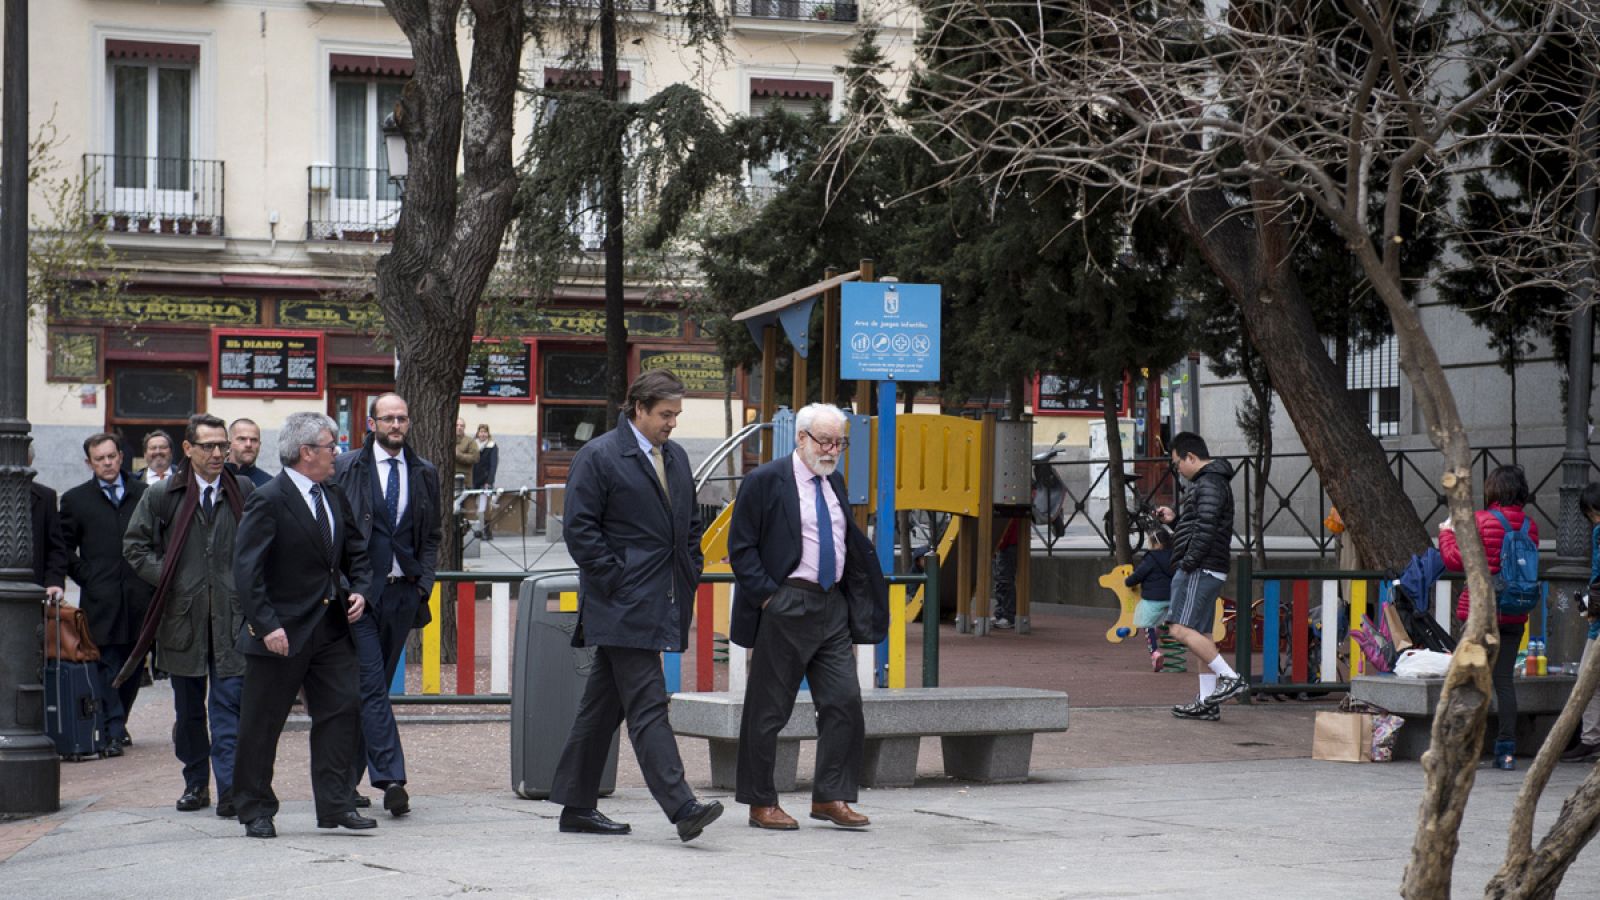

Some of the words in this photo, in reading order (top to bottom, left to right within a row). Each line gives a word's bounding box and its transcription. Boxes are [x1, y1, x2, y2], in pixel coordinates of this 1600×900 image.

[305, 308, 340, 320] EL
[549, 316, 629, 328] VINO
[225, 340, 240, 348] EL
[243, 340, 284, 349] DIARIO
